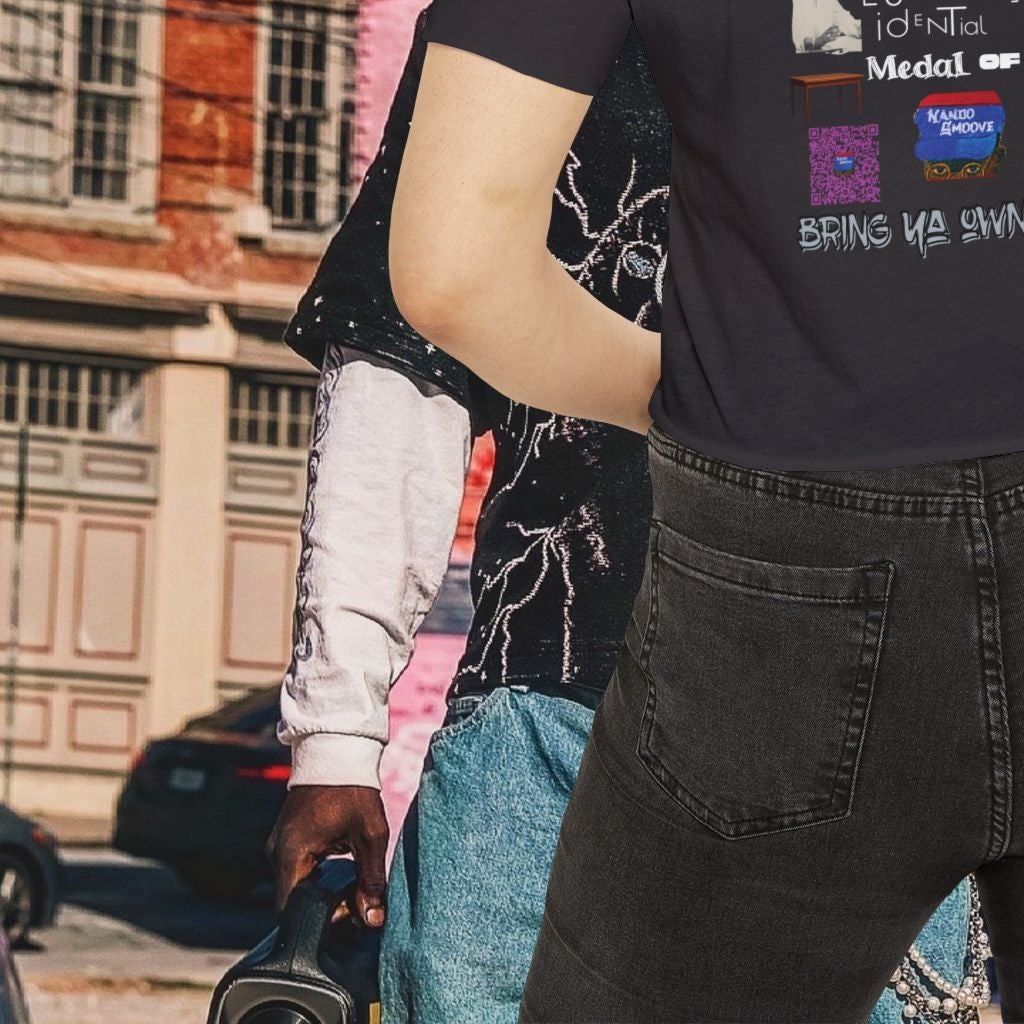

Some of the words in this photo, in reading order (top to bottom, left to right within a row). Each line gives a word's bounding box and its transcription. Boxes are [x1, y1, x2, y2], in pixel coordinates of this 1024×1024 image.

[865, 51, 972, 81] Medal
[979, 52, 1021, 71] OF
[798, 212, 892, 253] BRING
[902, 208, 950, 259] YA
